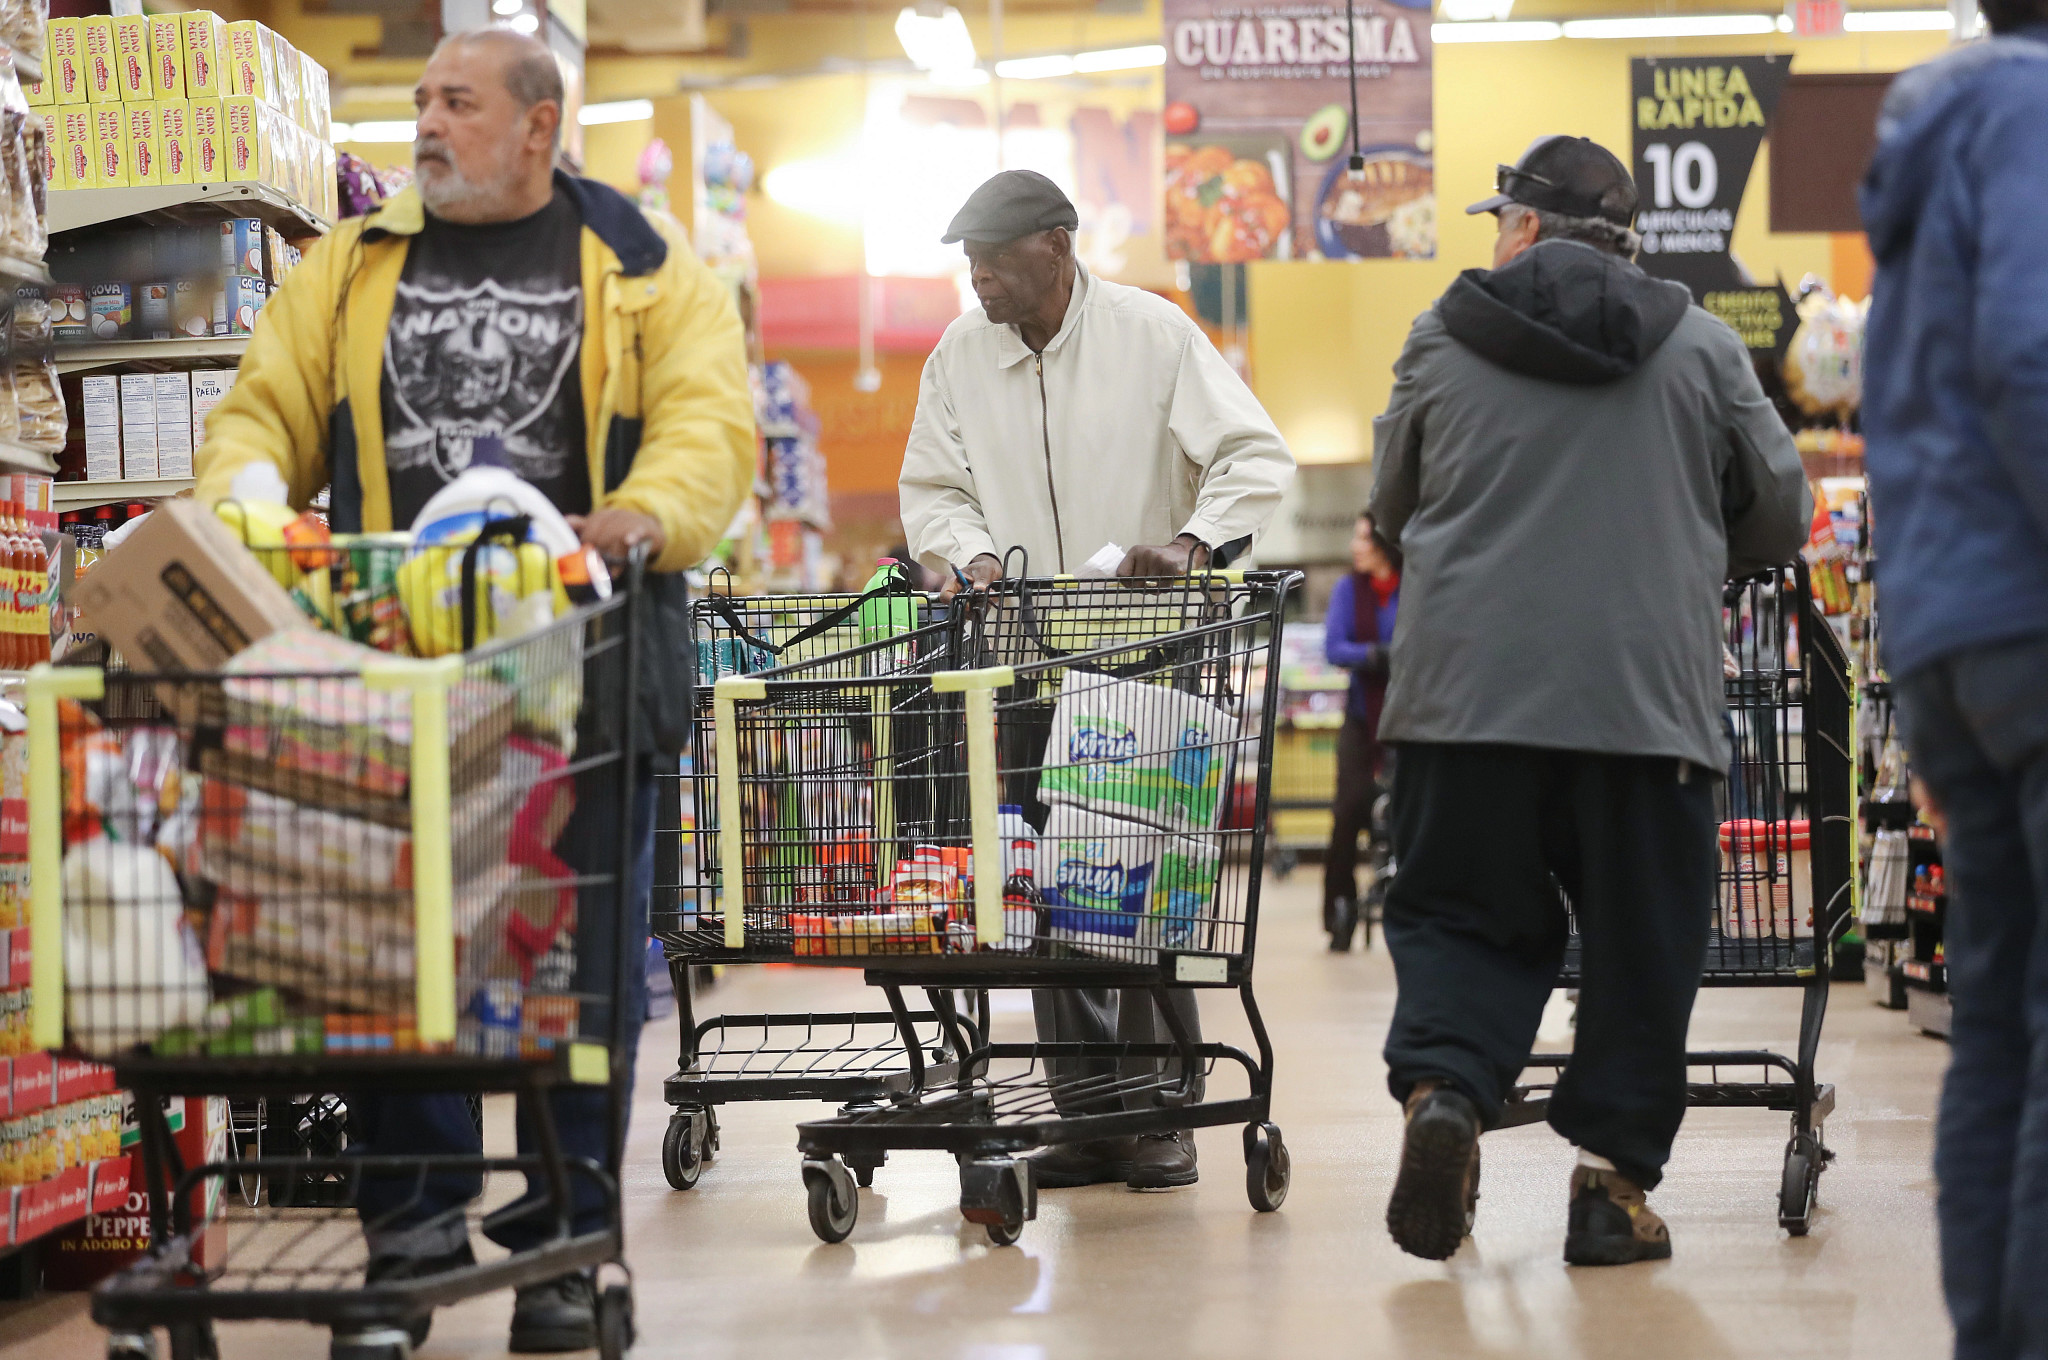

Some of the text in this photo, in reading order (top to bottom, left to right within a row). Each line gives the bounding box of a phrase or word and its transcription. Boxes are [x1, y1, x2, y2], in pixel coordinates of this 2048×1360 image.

[55, 28, 65, 56] MEIN
[65, 28, 76, 55] CHAO
[88, 26, 98, 55] MEIN
[97, 26, 108, 54] CHAO
[118, 26, 130, 54] MEIN
[129, 24, 140, 52] CHAO
[156, 24, 165, 52] MEIN
[165, 23, 176, 51] CHAO
[188, 22, 198, 50] MEIN
[199, 21, 208, 48] CHAO
[233, 32, 243, 59] MEIN
[243, 31, 254, 58] CHAO
[1174, 17, 1419, 66] CUARESMA
[45, 115, 55, 143] CHAO
[66, 114, 76, 142] MEIN
[77, 114, 87, 141] CHAO
[99, 112, 108, 140] MEIN
[109, 112, 118, 139] CHAO
[132, 111, 141, 139] MEIN
[142, 111, 151, 138] CHAO
[164, 109, 173, 138] MEIN
[173, 109, 183, 136] CHAO
[196, 107, 205, 135] MEIN
[206, 107, 215, 134] CHAO
[230, 105, 239, 133] MEIN
[240, 106, 250, 133] CHAO
[1643, 141, 1718, 209] 10
[17, 288, 40, 298] OYA
[92, 284, 120, 295] GOYA
[398, 308, 560, 346] NATION
[196, 387, 221, 397] PAELLA
[86, 1216, 150, 1238] PEPPE
[62, 1240, 77, 1250] IN
[82, 1238, 131, 1250] ADOBO
